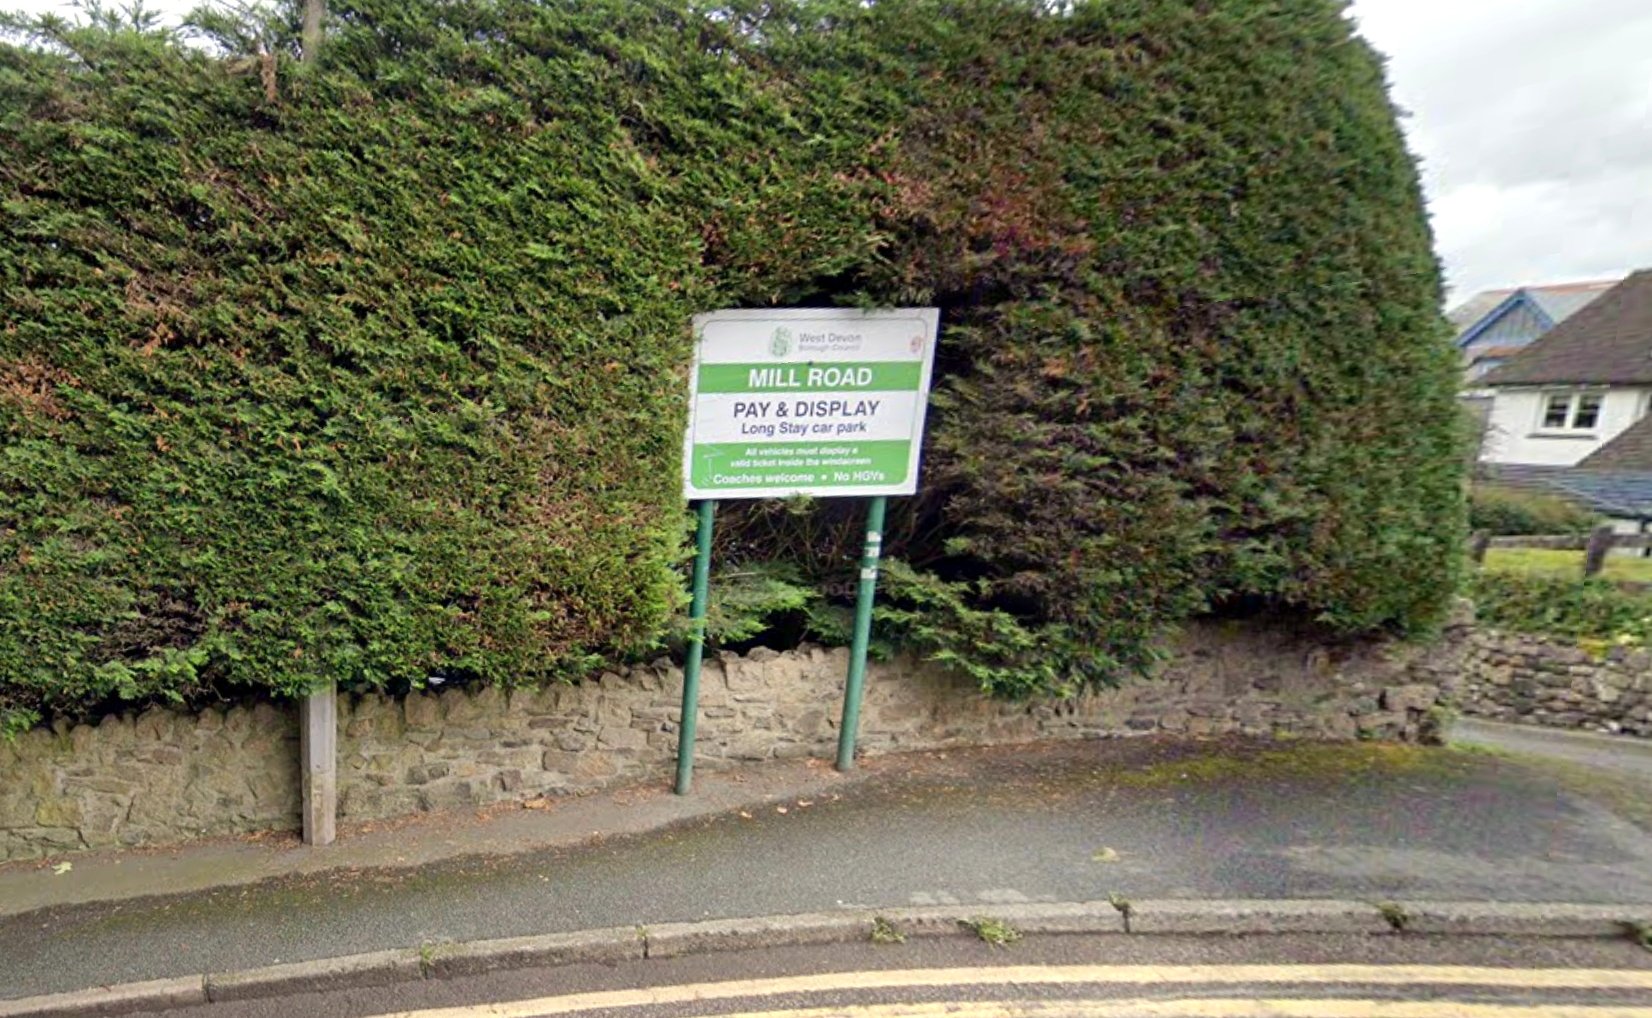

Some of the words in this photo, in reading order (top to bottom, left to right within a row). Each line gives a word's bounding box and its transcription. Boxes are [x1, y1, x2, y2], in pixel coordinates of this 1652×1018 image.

[799, 333, 826, 343] West
[828, 332, 862, 343] Devon
[749, 368, 800, 387] MILL
[808, 367, 872, 387] ROAD
[733, 401, 771, 418] PAY
[776, 401, 789, 417] &
[795, 400, 880, 417] DISPLAY
[741, 422, 774, 436] Long
[779, 421, 809, 436] Stay
[812, 423, 833, 434] car
[837, 421, 867, 435] park
[758, 447, 794, 456] vehicles
[796, 447, 817, 456] must
[819, 446, 850, 457] display
[752, 458, 777, 468] ticket
[778, 458, 804, 467] inside
[806, 457, 820, 467] the
[821, 456, 872, 467] windscreen
[713, 473, 763, 485] Coaches
[764, 472, 815, 484] welcome
[834, 471, 850, 482] No
[852, 470, 885, 482] HGVs
